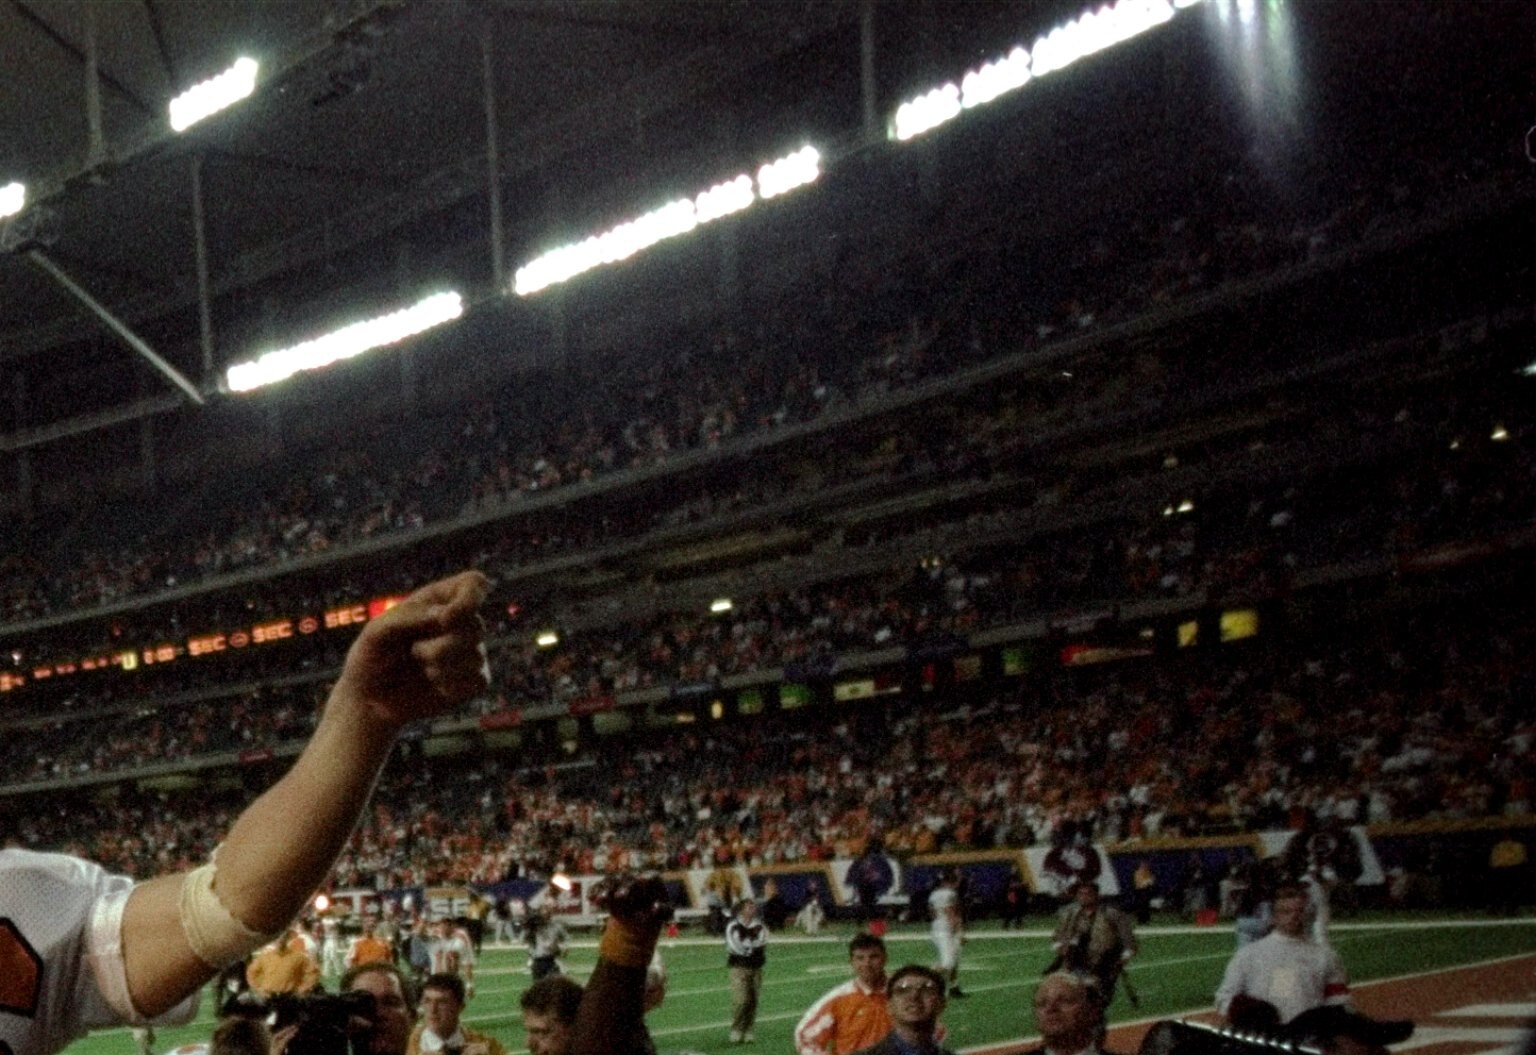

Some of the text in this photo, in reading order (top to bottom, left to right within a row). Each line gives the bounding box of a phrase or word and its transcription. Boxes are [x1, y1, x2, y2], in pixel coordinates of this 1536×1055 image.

[324, 605, 366, 629] SEC
[252, 621, 293, 644] SEC
[188, 635, 227, 656] SEC
